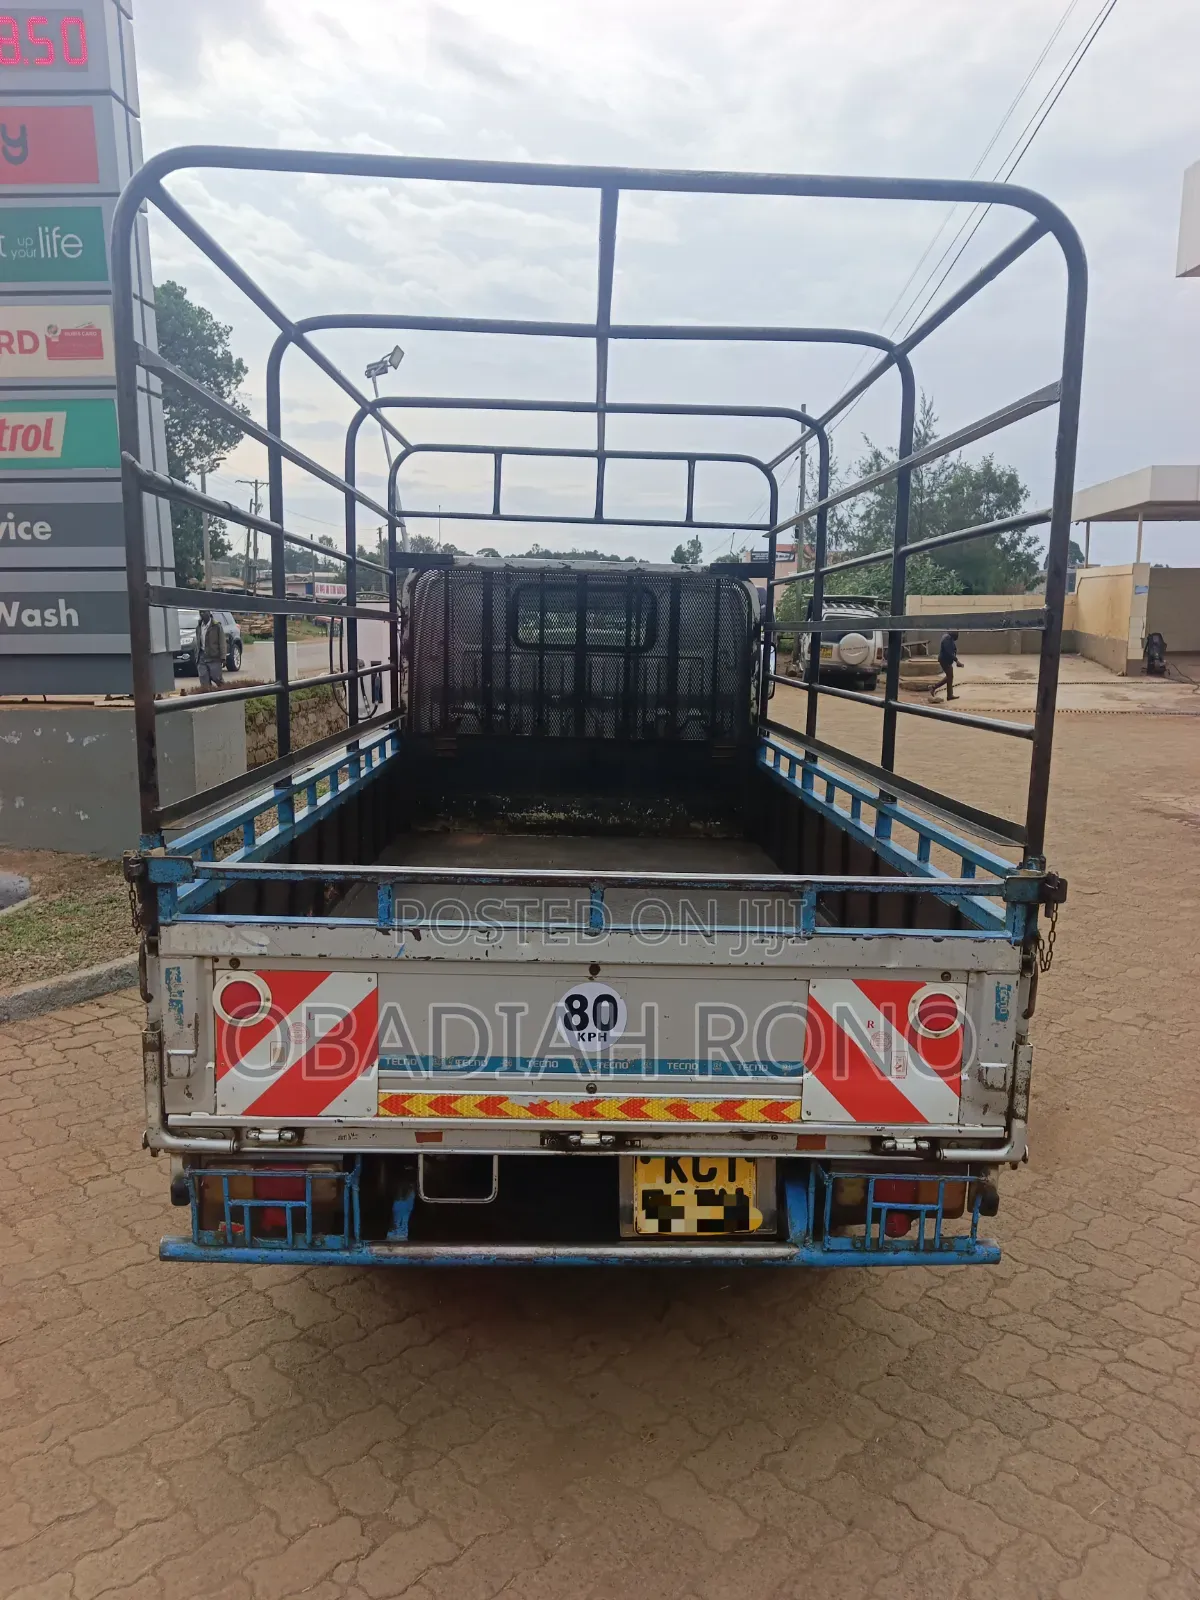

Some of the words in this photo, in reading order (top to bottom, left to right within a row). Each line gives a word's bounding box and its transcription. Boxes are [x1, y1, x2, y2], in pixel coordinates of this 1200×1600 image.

[18, 236, 33, 247] up
[38, 226, 83, 259] life
[10, 248, 36, 260] your
[0, 329, 40, 355] RD
[563, 993, 618, 1032] 80
[867, 1020, 875, 1029] R
[577, 1032, 607, 1042] KPH
[385, 1057, 417, 1067] TECNO
[455, 1058, 488, 1067] TECNO
[528, 1059, 558, 1069] TECNO
[597, 1061, 629, 1070] TECNO
[666, 1062, 699, 1071] TECNO
[737, 1063, 768, 1072] TECNO
